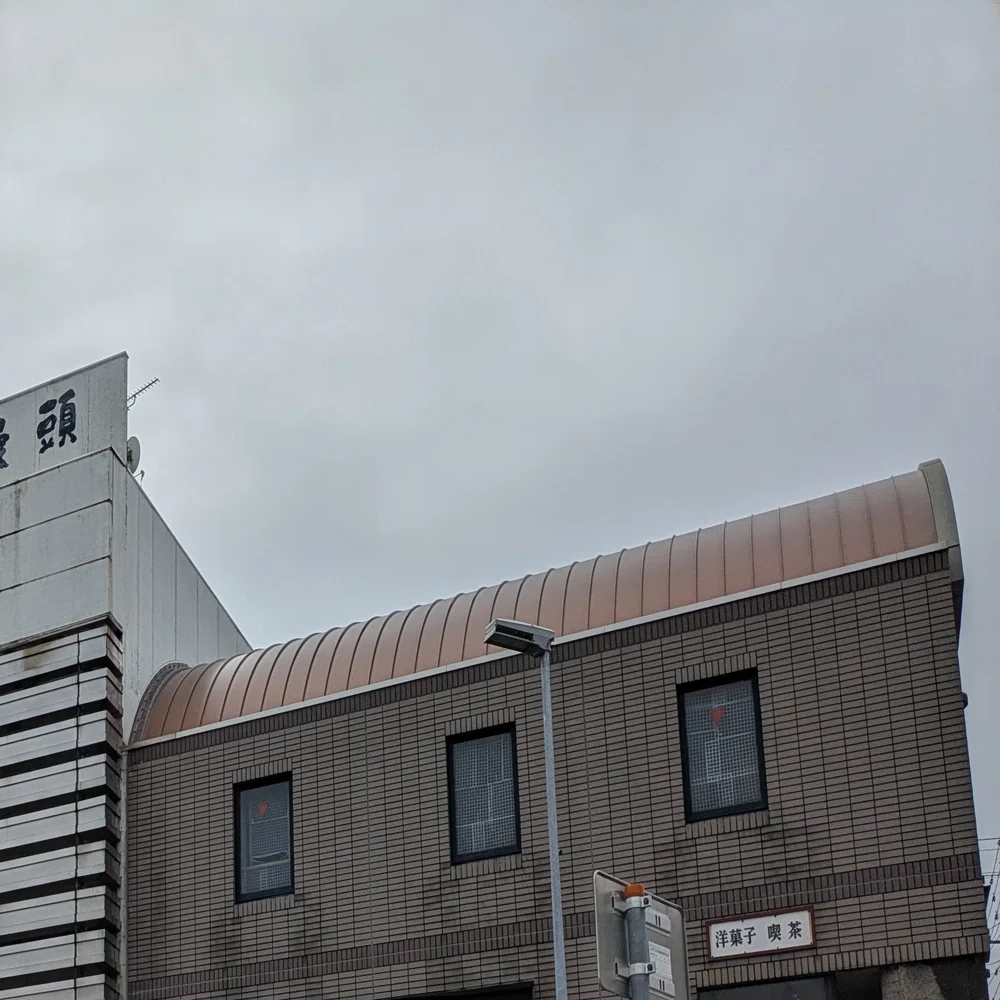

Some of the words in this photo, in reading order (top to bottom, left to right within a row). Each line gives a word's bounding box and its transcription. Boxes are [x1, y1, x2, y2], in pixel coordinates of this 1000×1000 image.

[715, 927, 757, 949] 洋菓子
[767, 920, 803, 943] 喫茶
